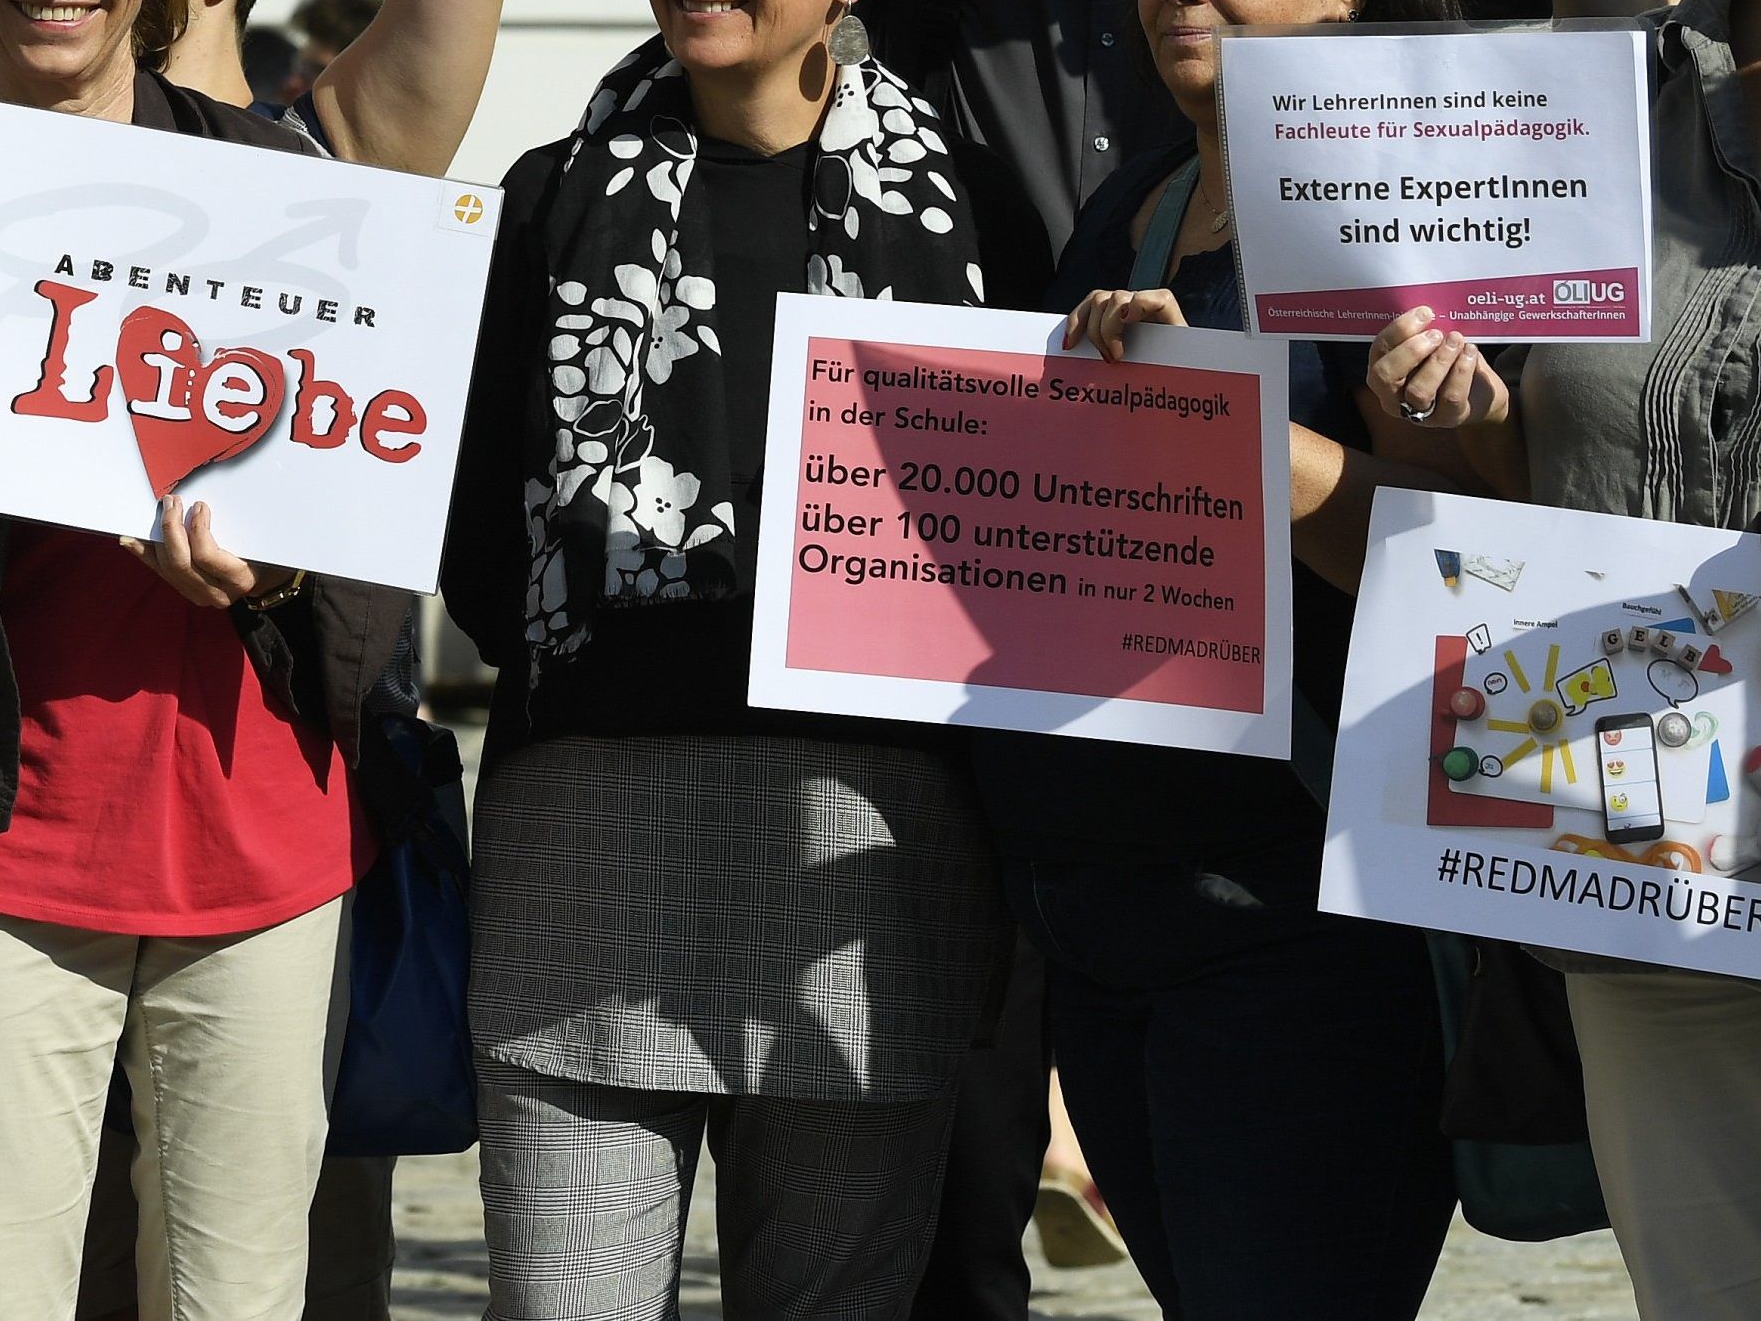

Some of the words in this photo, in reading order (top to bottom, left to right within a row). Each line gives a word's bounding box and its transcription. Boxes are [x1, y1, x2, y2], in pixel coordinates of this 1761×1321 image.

[1272, 94, 1306, 112] Wir
[1312, 92, 1437, 111] LehrerInnen
[1443, 91, 1486, 109] sind
[1492, 90, 1548, 109] keine
[1275, 122, 1371, 141] Fachleute
[1377, 121, 1407, 139] für
[1413, 118, 1590, 142] Sexualpädagogik.
[1280, 177, 1389, 202] Externe
[1400, 174, 1588, 207] ExpertInnen
[1340, 218, 1399, 245] sind
[1410, 216, 1531, 248] wichtig!
[54, 254, 376, 328] ABENTEUER
[1467, 292, 1546, 308] oeli-ug.at
[1268, 307, 1334, 319] Österreichische
[1449, 310, 1515, 322] Unabhängige
[1518, 309, 1626, 321] GewerkschafterInnen
[11, 279, 427, 463] Liebe
[811, 359, 855, 384] Für
[863, 365, 1040, 401] qualitätsvolle
[1049, 379, 1231, 420] Sexualpädagogik
[808, 400, 831, 423] in
[841, 403, 886, 427] der
[894, 406, 988, 436] Schule:
[805, 455, 887, 488] über
[898, 462, 1021, 499] 20.000
[1033, 473, 1243, 521] Unterschriften
[801, 504, 883, 537] über
[898, 511, 961, 544] 100
[974, 523, 1215, 566] unterstützende
[798, 544, 1066, 594] Organisationen
[1078, 577, 1096, 598] in
[1104, 585, 1137, 602] nur
[1143, 583, 1155, 603] 2
[1161, 583, 1235, 611] Wochen
[1536, 620, 1558, 630] Ampel
[1622, 602, 1662, 616] Bauchgefühl
[1122, 634, 1261, 665] #REDMADRÜBER
[1438, 848, 1761, 933] #REDMADRÜBER
